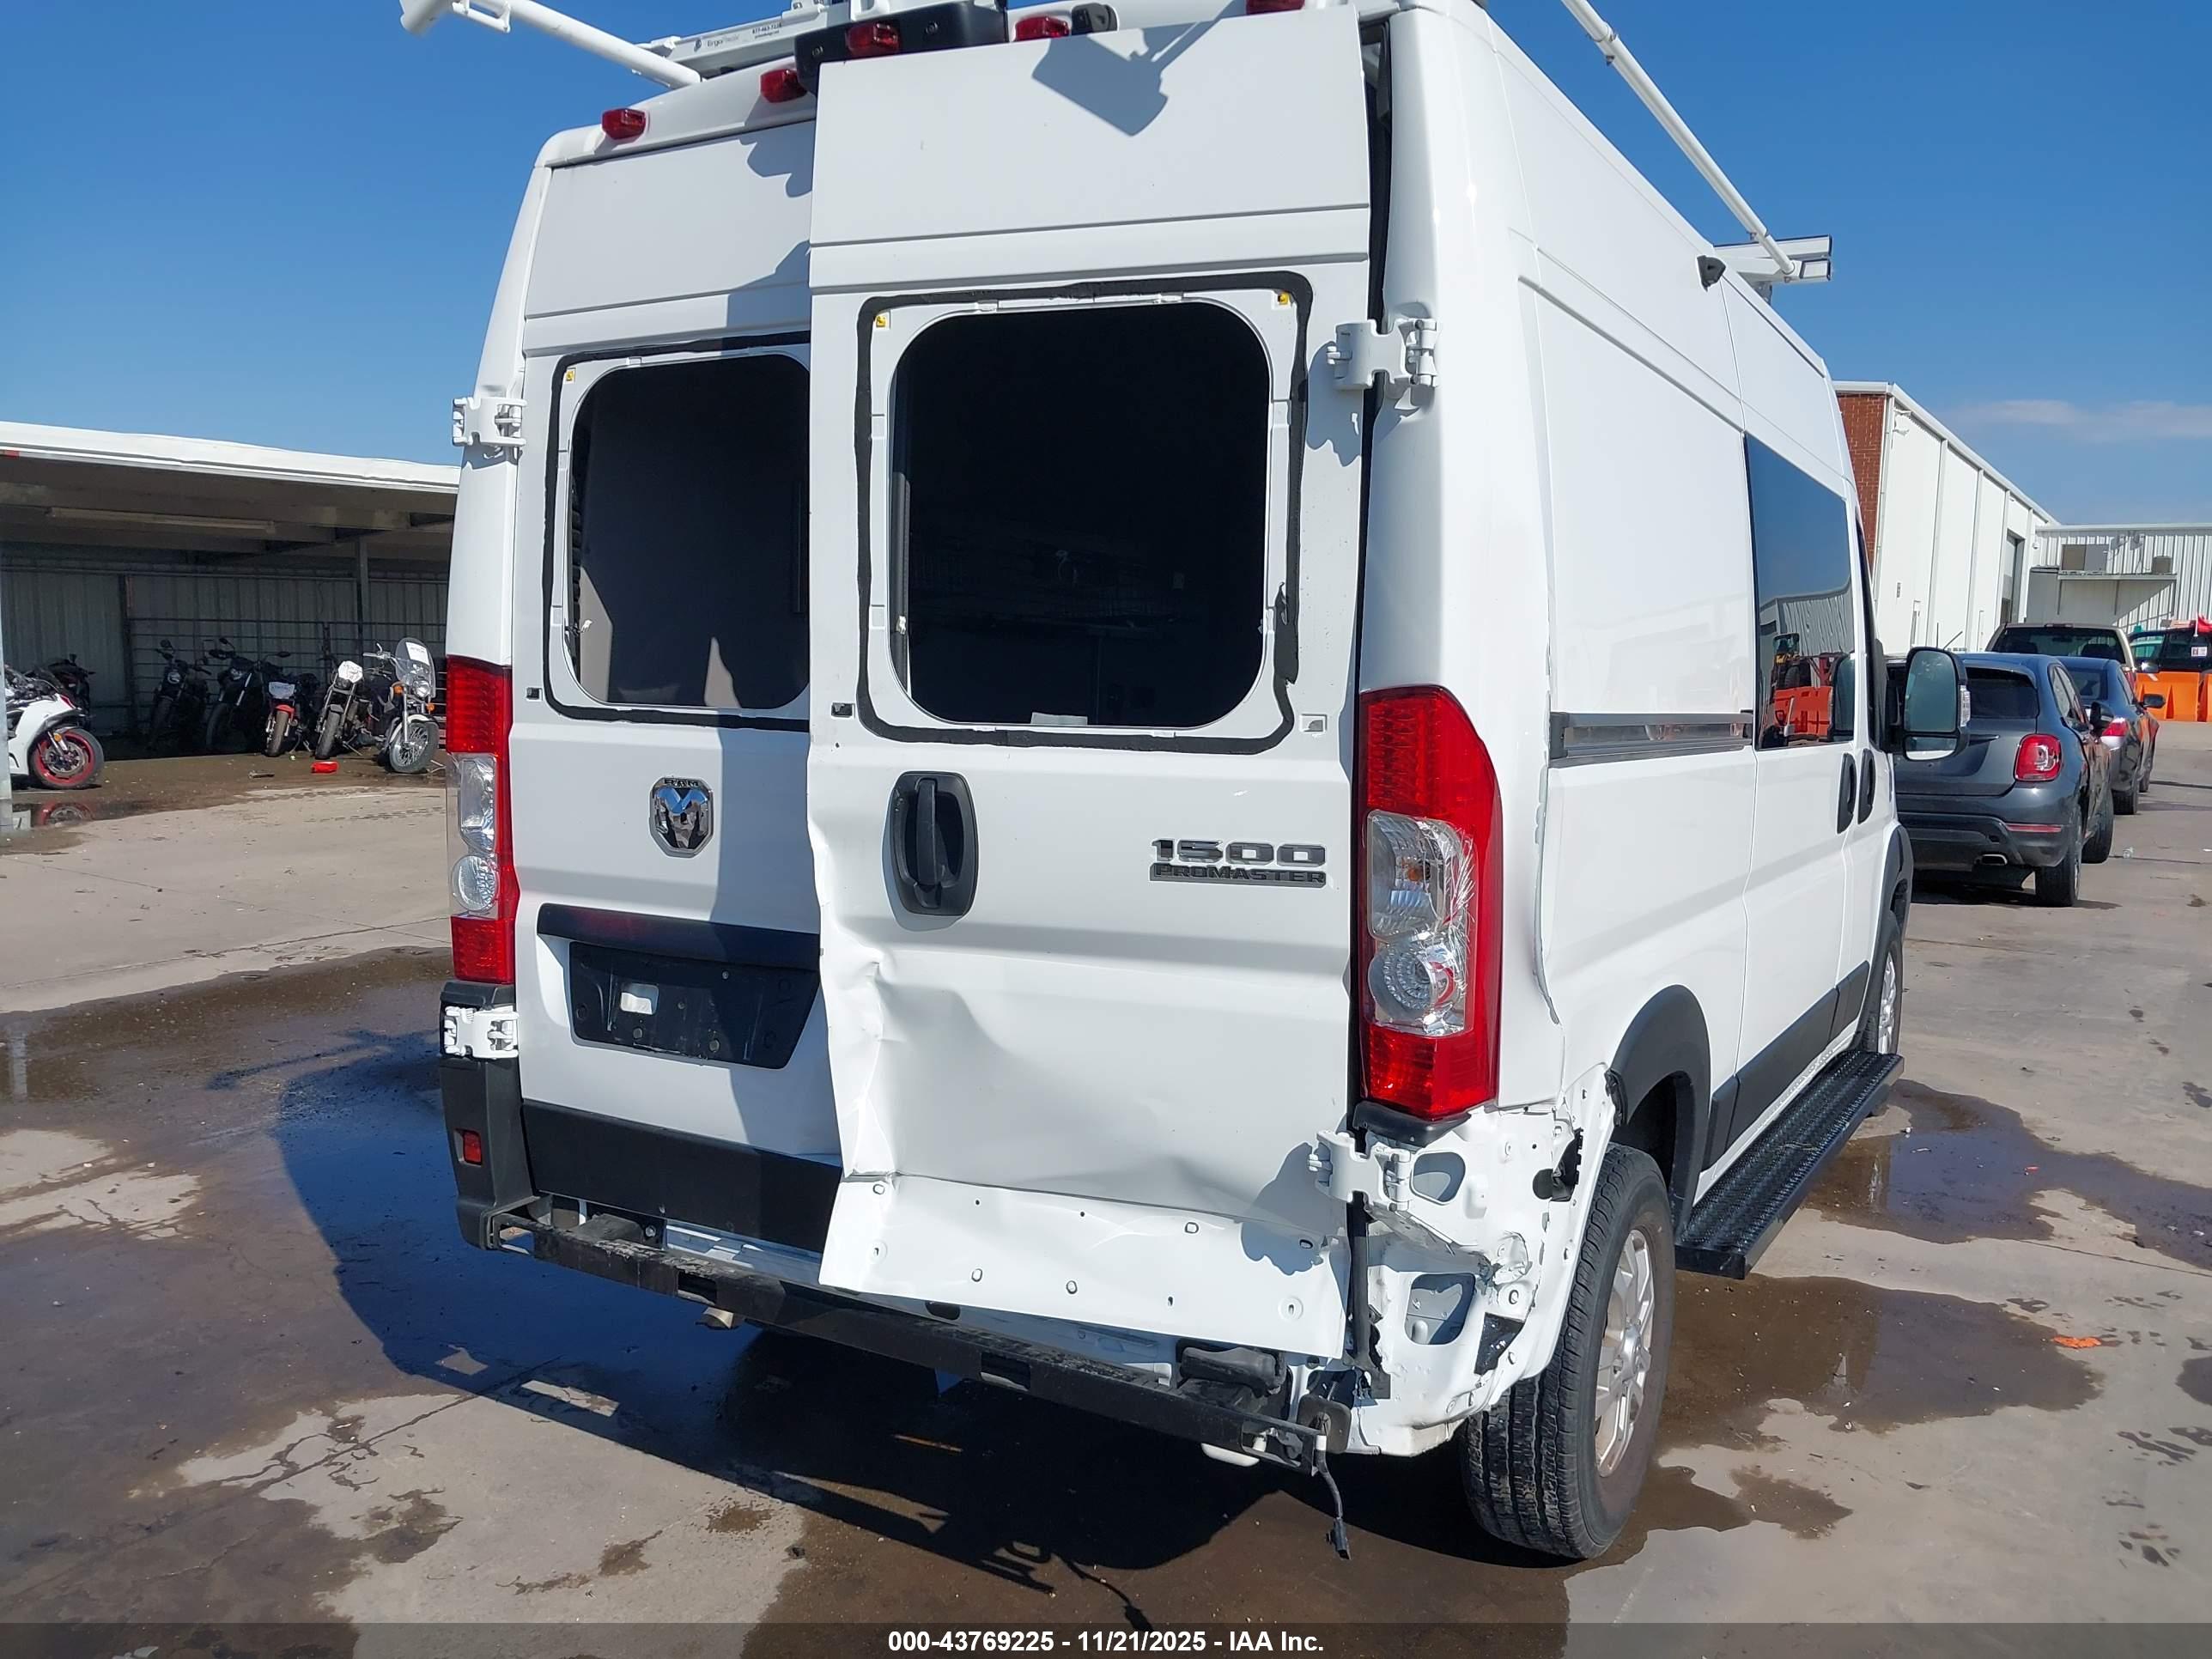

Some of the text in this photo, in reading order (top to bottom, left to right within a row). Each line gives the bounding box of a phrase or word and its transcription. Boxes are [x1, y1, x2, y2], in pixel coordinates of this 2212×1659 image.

[664, 778, 699, 787] RAM
[1152, 839, 1326, 867] 1500
[1151, 864, 1327, 888] PROMASTER
